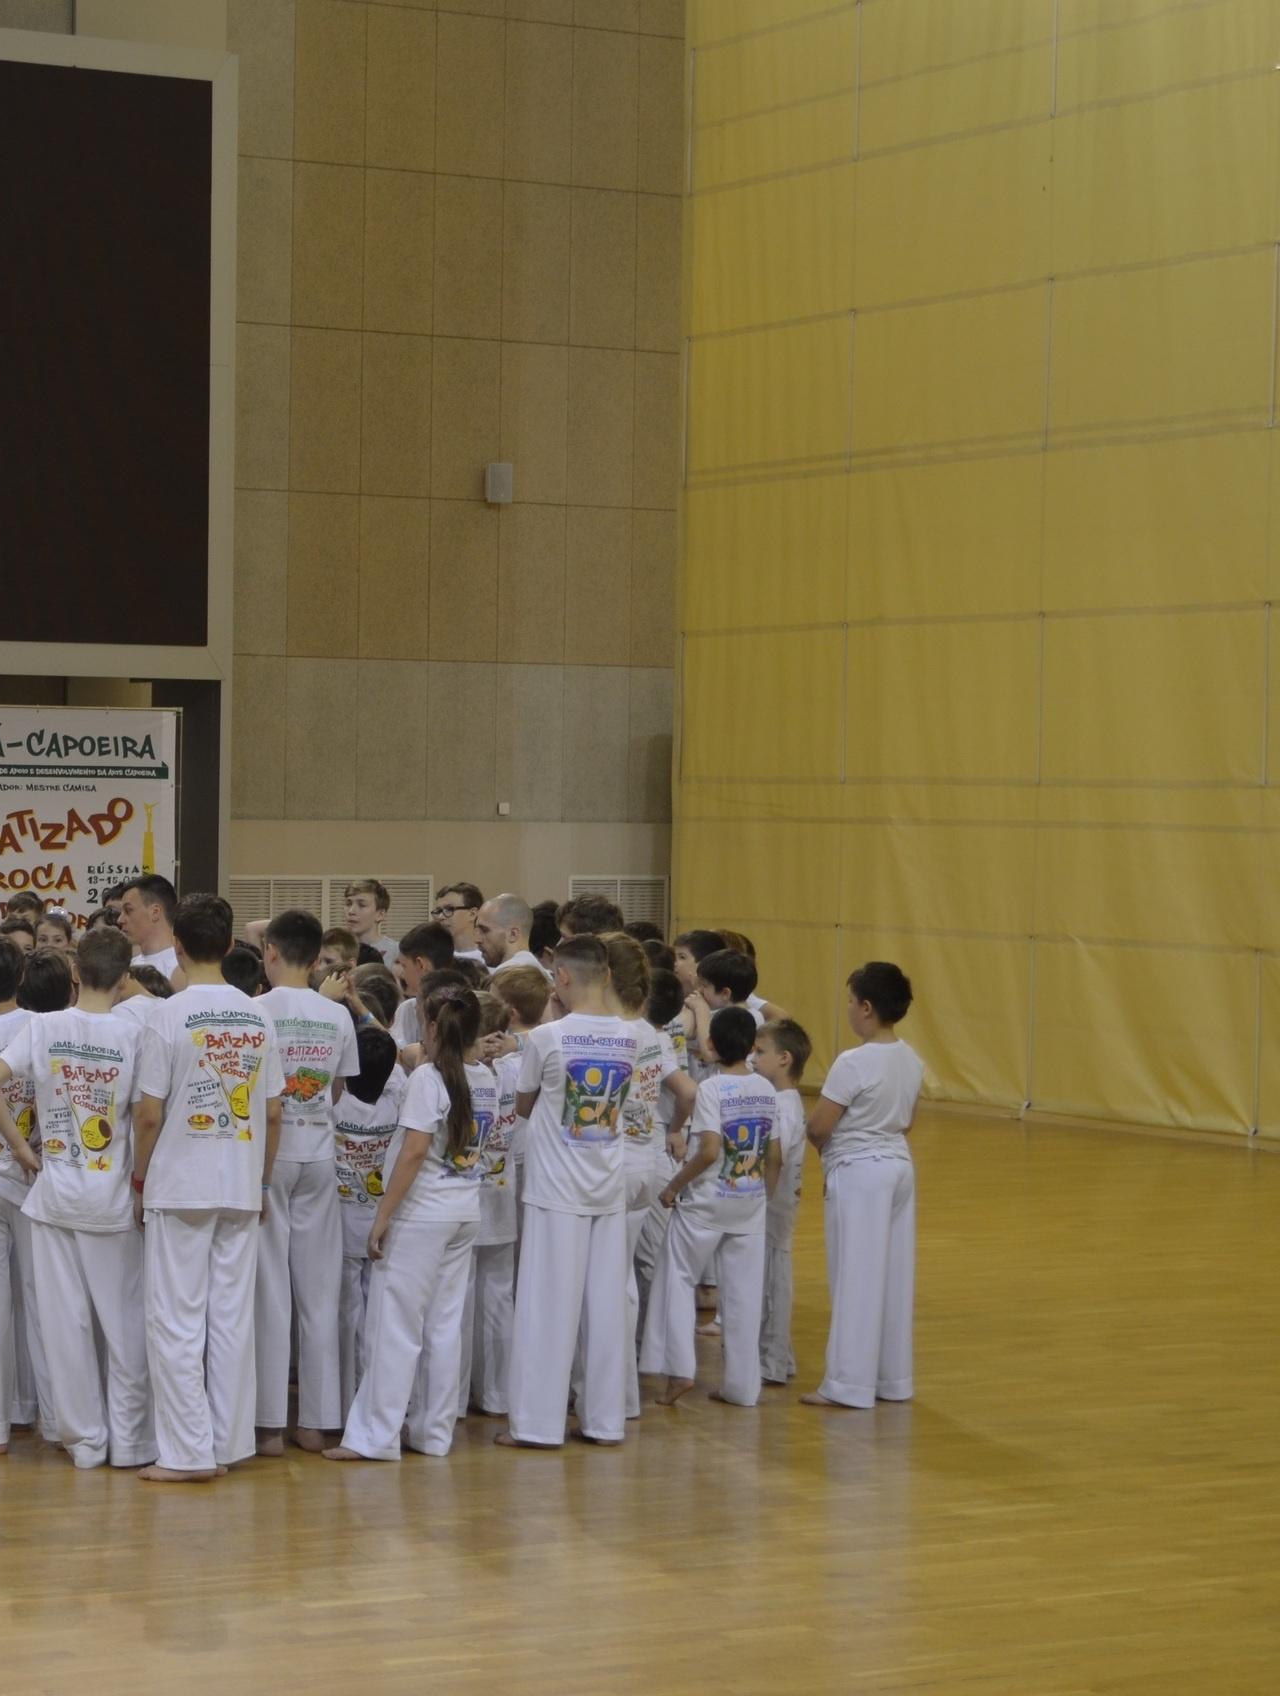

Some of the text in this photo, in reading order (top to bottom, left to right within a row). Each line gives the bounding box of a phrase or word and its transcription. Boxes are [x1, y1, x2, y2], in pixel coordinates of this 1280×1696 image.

[36, 768, 96, 776] DESENVOLVIMENTO
[124, 768, 157, 777] CAPOEIRA
[26, 783, 60, 792] MESTRE
[63, 783, 97, 793] CAMISA
[87, 861, 140, 874] RÚSSIA
[205, 1031, 265, 1050] BATIZADO
[205, 1051, 240, 1063] TROCA
[61, 1065, 119, 1084] BATIZADO
[72, 1094, 108, 1116] CORDAS
[344, 1135, 393, 1153] BATIZAD
